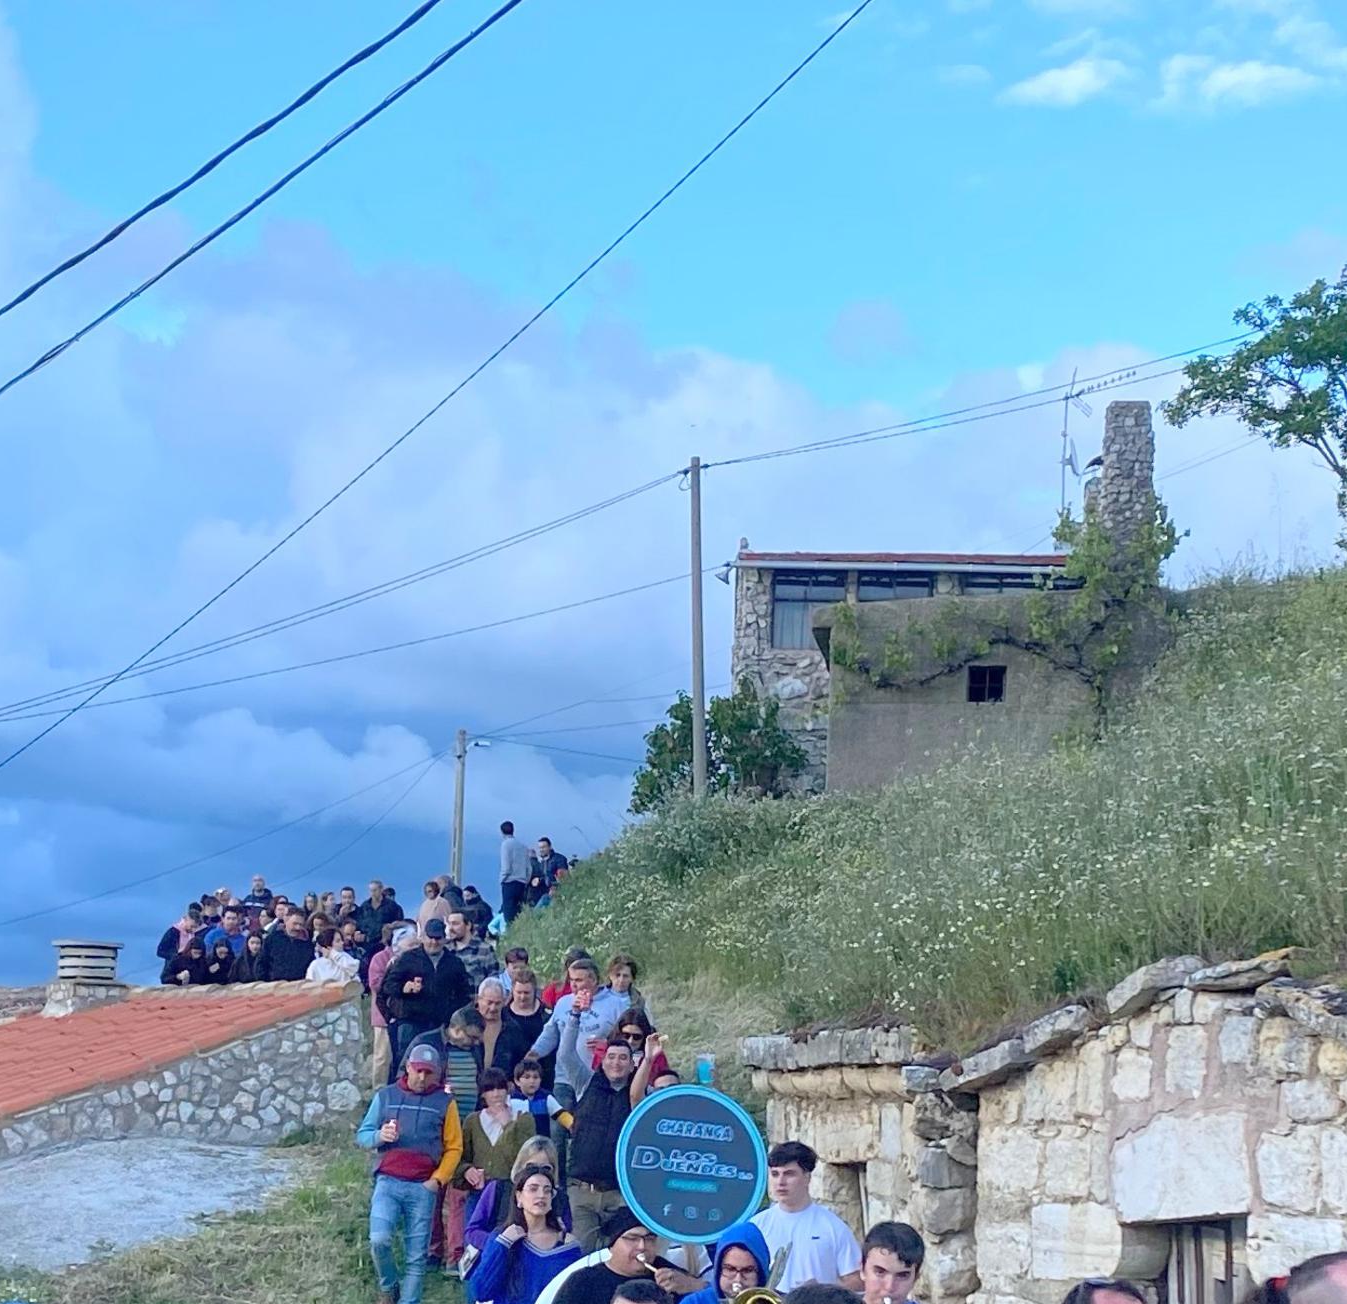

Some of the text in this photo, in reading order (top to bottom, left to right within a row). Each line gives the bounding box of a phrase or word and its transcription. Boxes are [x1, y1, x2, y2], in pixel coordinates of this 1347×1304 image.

[656, 1118, 733, 1142] CHARANGA
[631, 1145, 738, 1178] DUENDES
[670, 1149, 719, 1164] LOS
